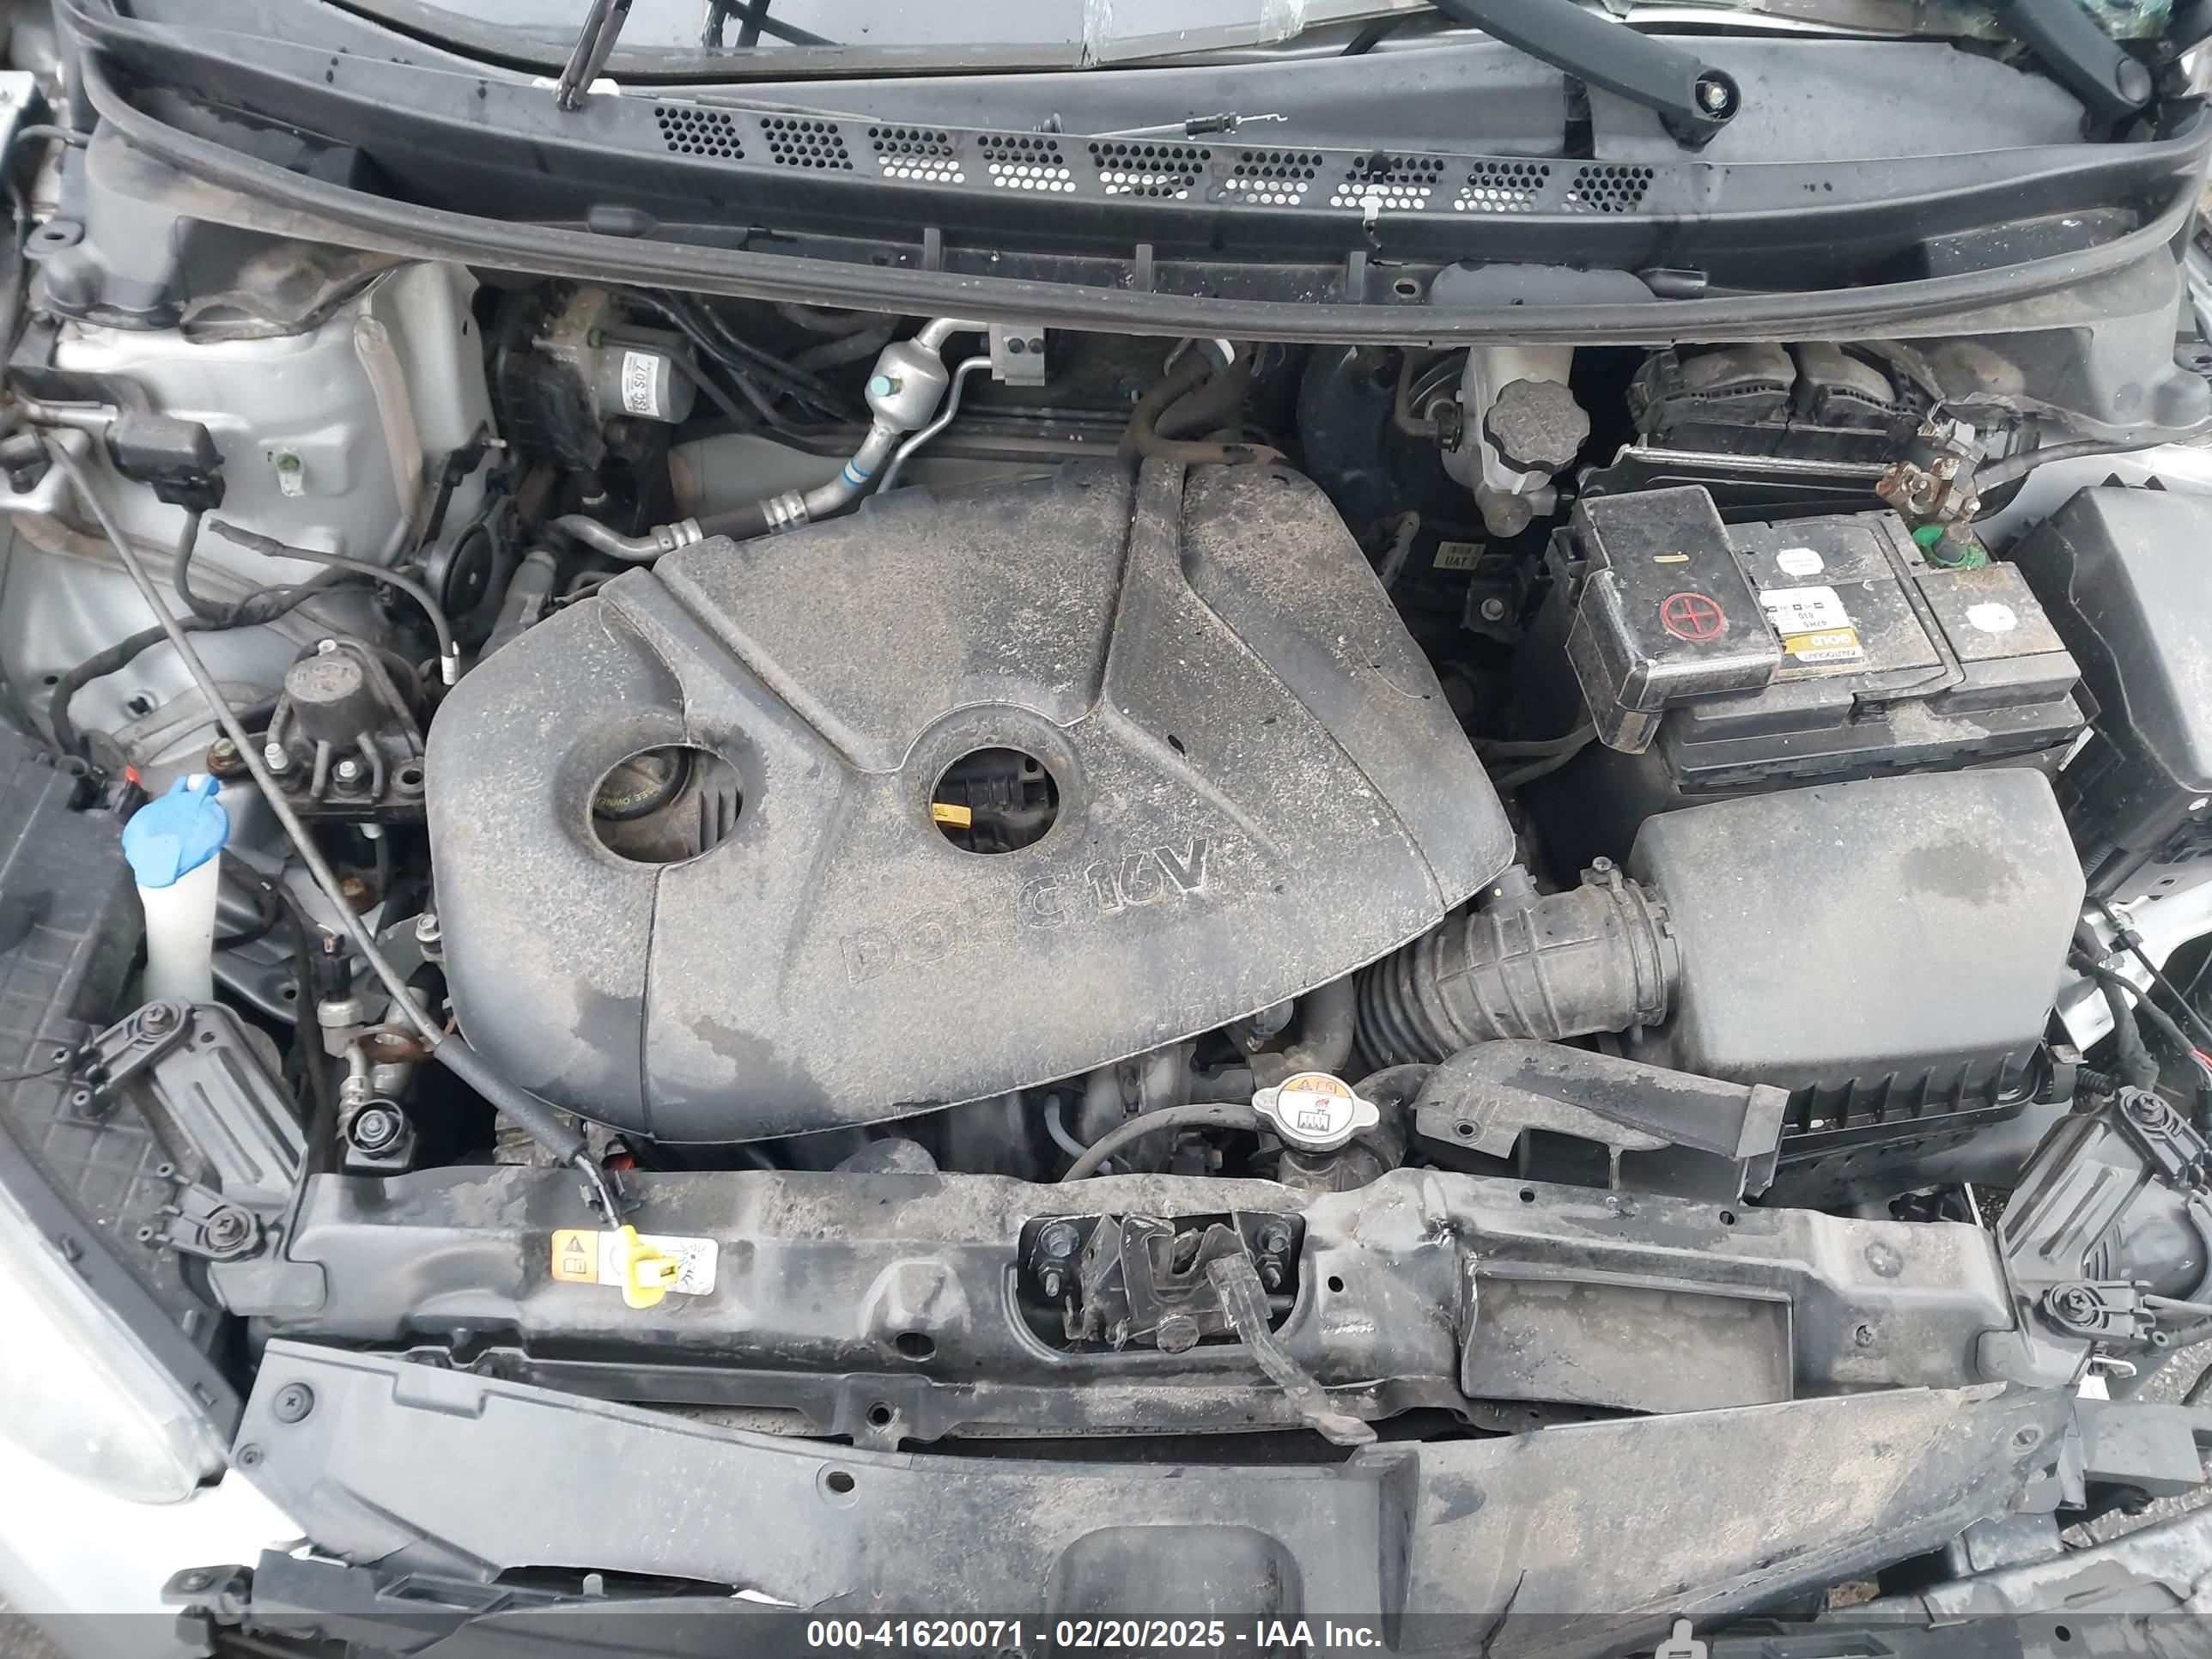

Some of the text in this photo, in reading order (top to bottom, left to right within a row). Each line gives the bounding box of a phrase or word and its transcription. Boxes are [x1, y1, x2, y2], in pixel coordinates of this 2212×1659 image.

[1810, 633, 1852, 647] GOLD
[633, 787, 656, 803] SEE
[1085, 838, 1209, 914] 16V
